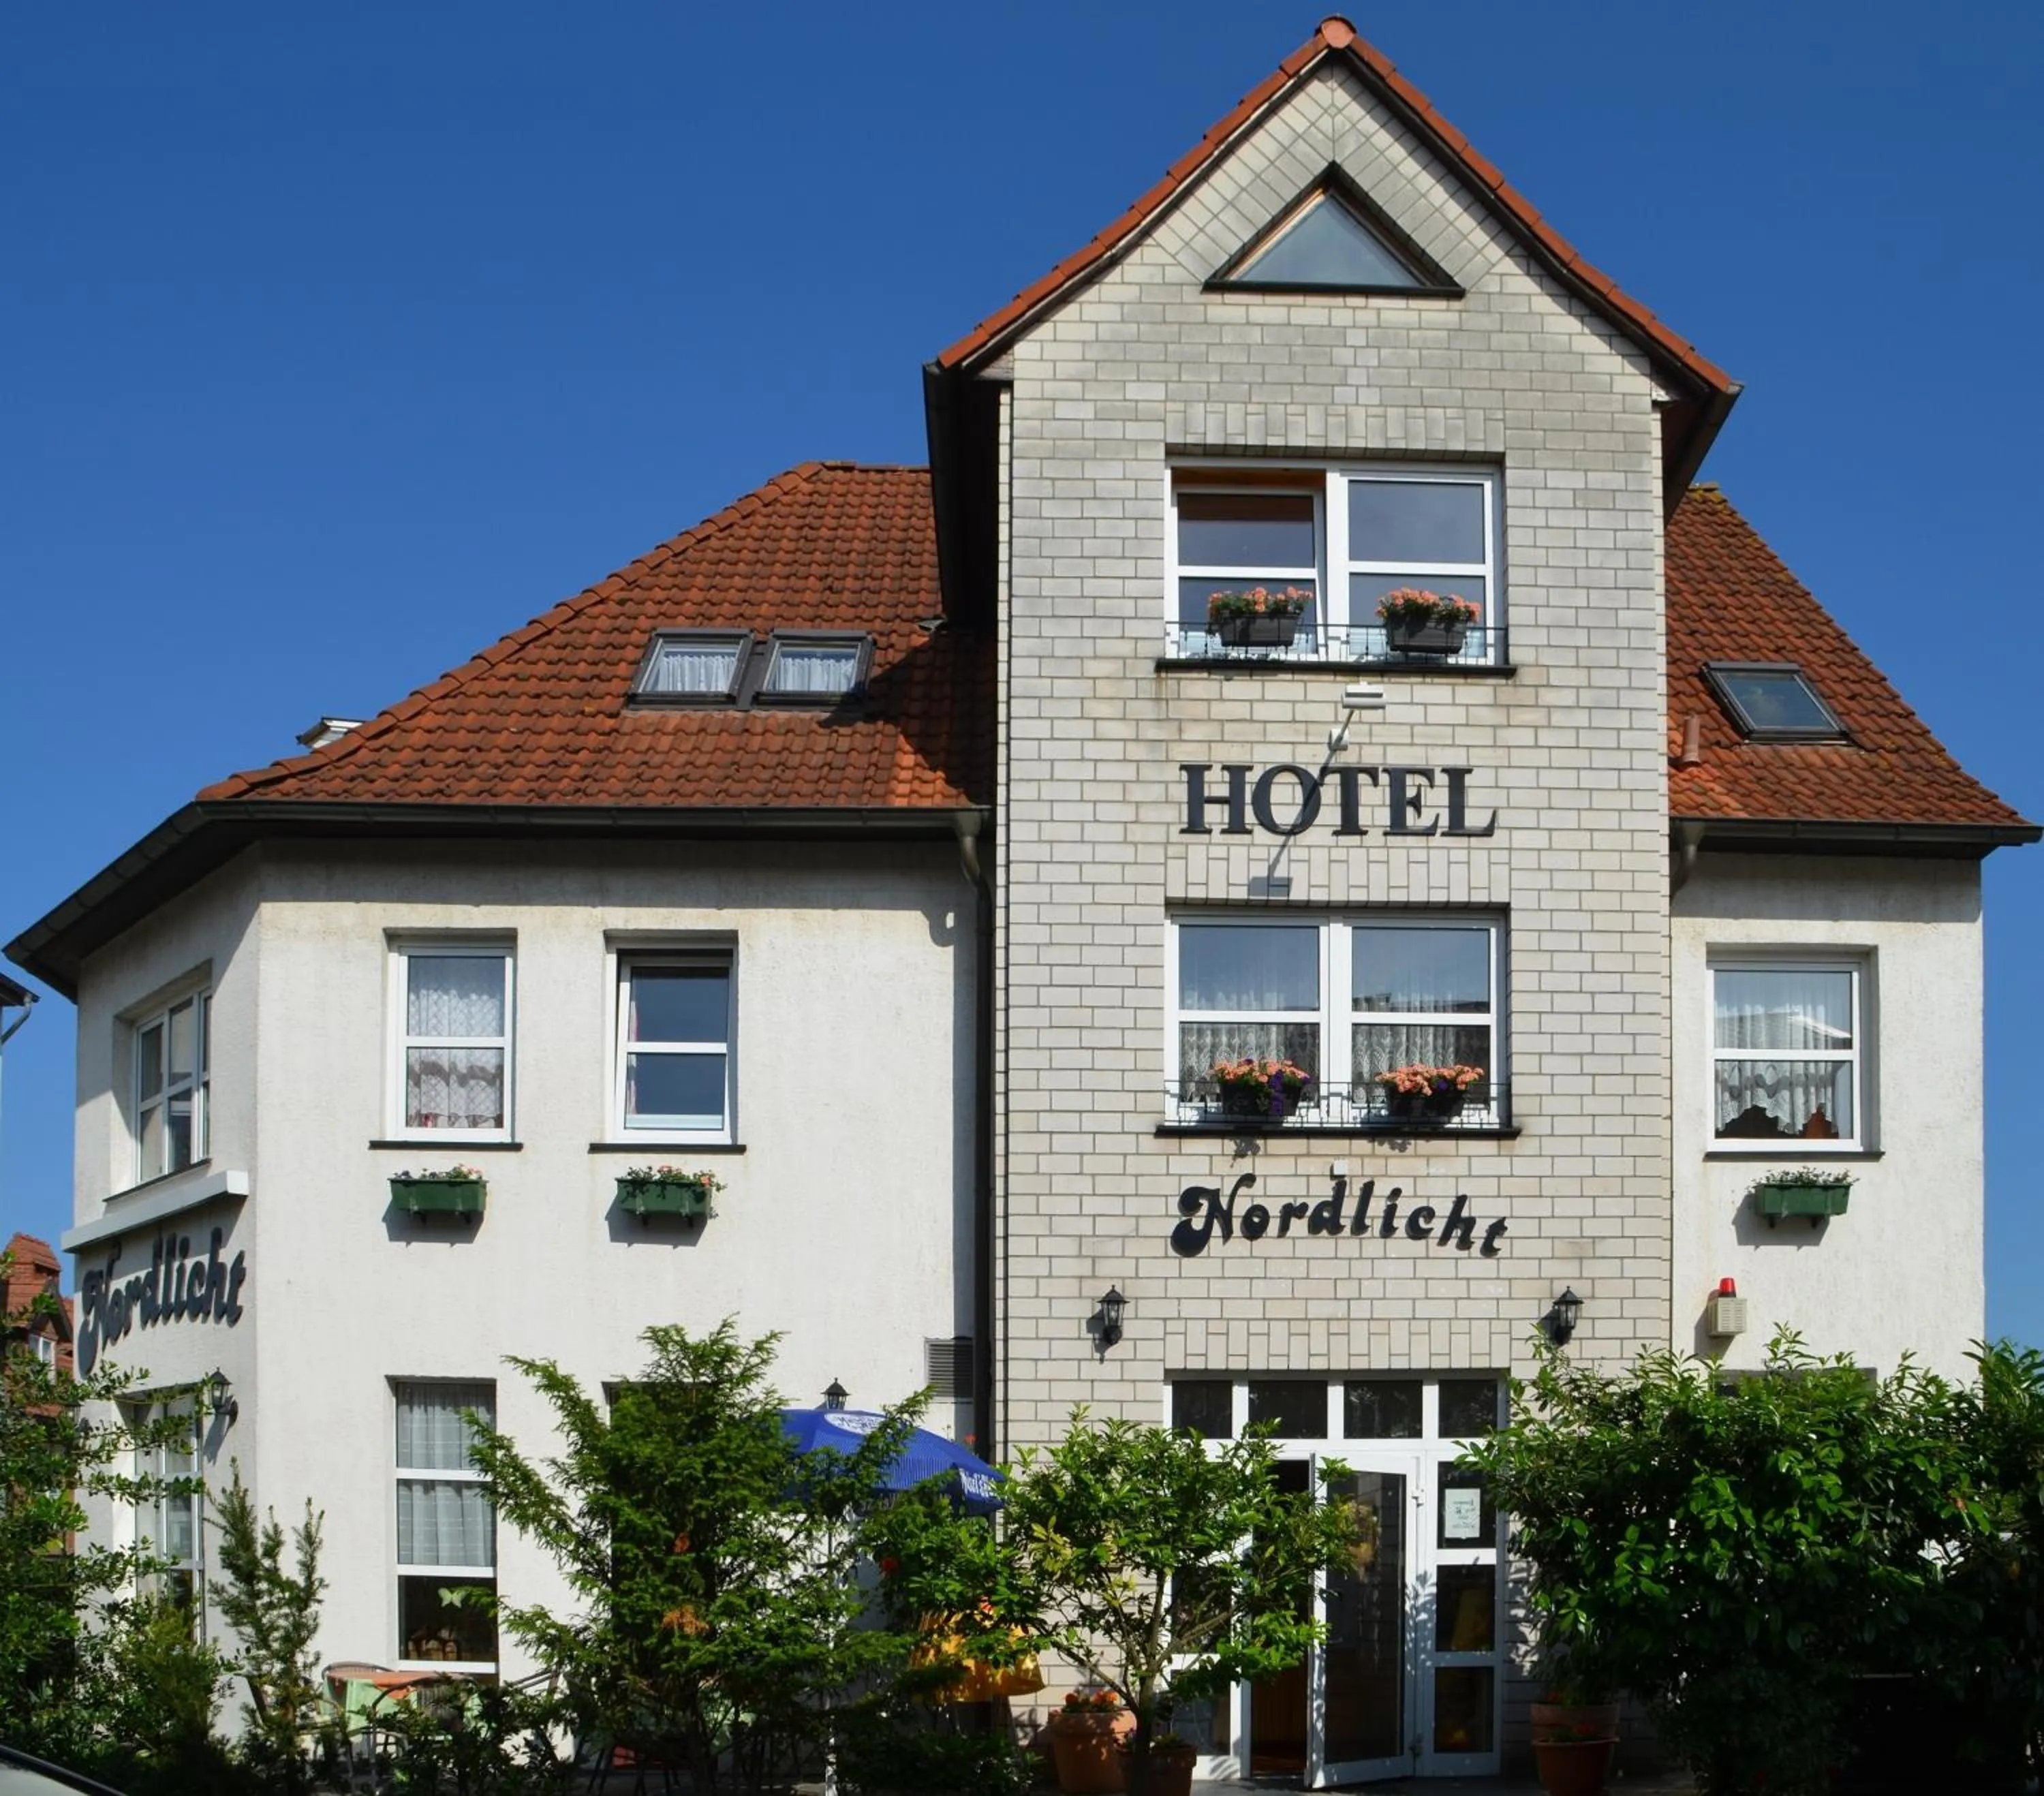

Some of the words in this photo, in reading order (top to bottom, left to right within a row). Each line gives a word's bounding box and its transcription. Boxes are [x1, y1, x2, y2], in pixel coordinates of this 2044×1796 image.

[1179, 763, 1497, 837] HOTEL
[1171, 1172, 1508, 1258] Nordlicht
[77, 1226, 247, 1380] Nordlicht
